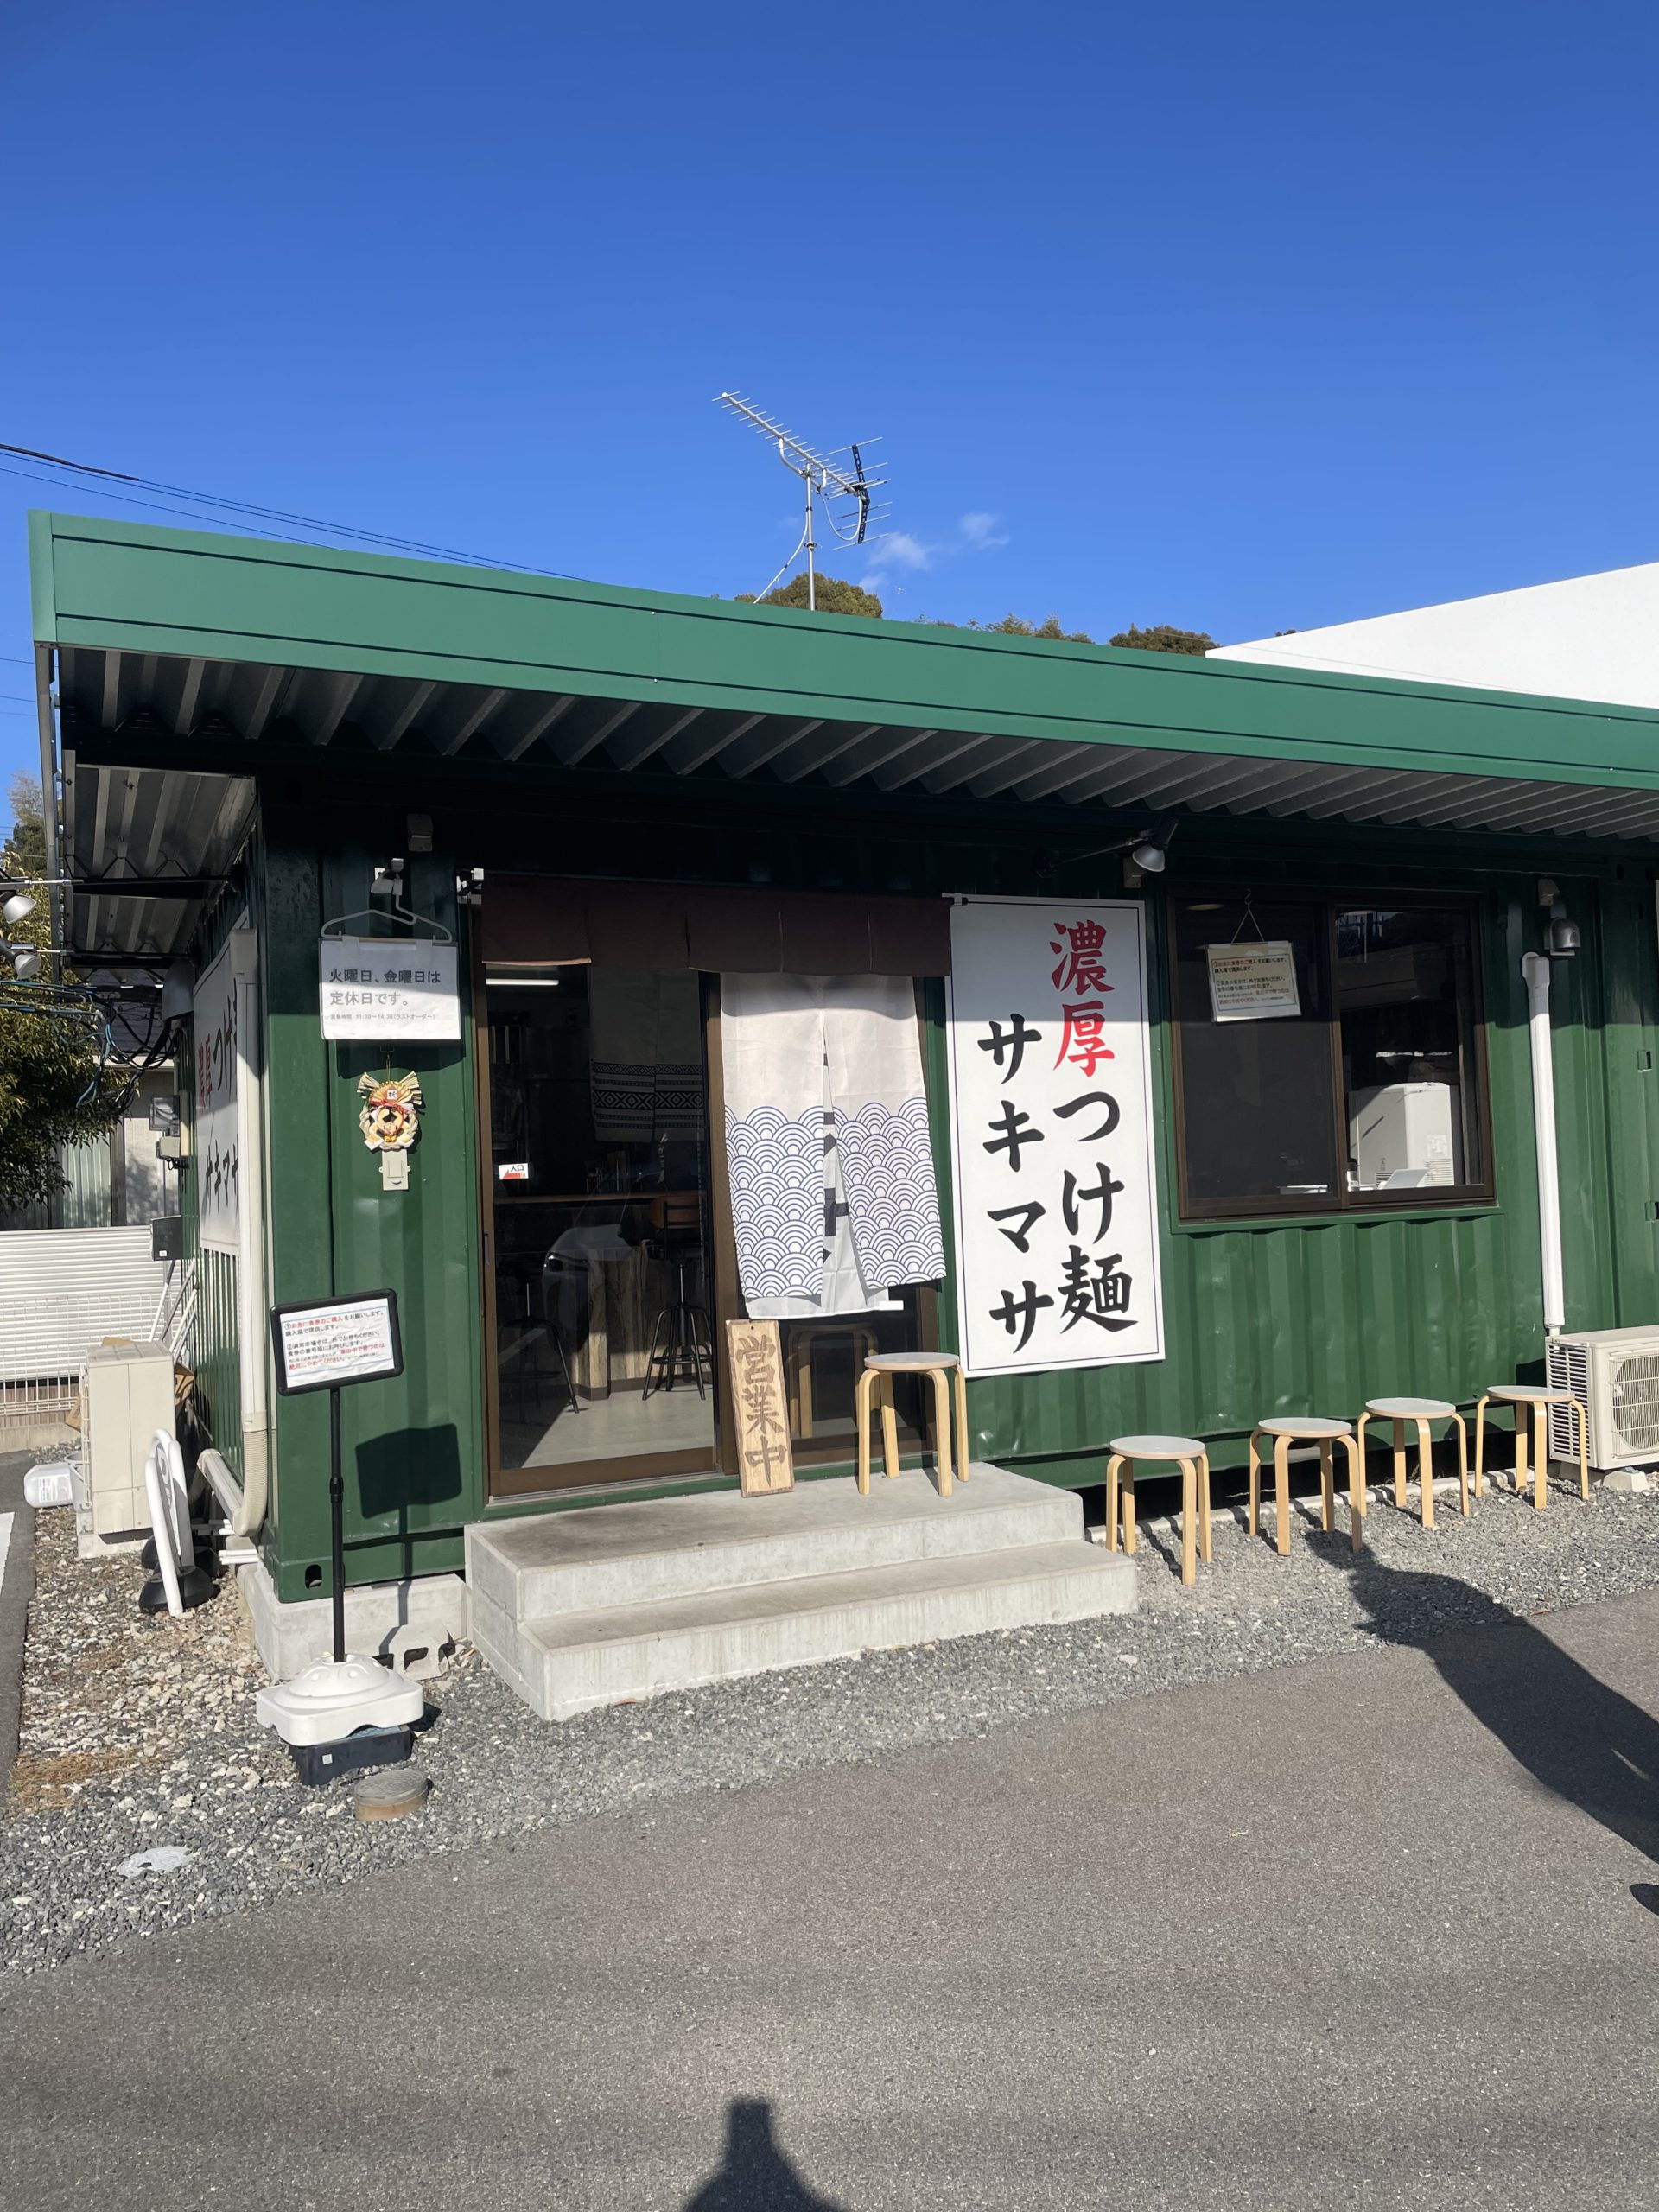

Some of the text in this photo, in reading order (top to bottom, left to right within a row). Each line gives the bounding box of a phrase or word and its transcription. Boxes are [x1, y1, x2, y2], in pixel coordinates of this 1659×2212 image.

[329, 968, 441, 983] 火曜日、金曜日は
[329, 991, 409, 1006] 定休日です。
[977, 1013, 1054, 1354] サキマサ
[1050, 919, 1139, 1334] 濃厚つけ麺
[736, 1334, 787, 1487] 営業中
